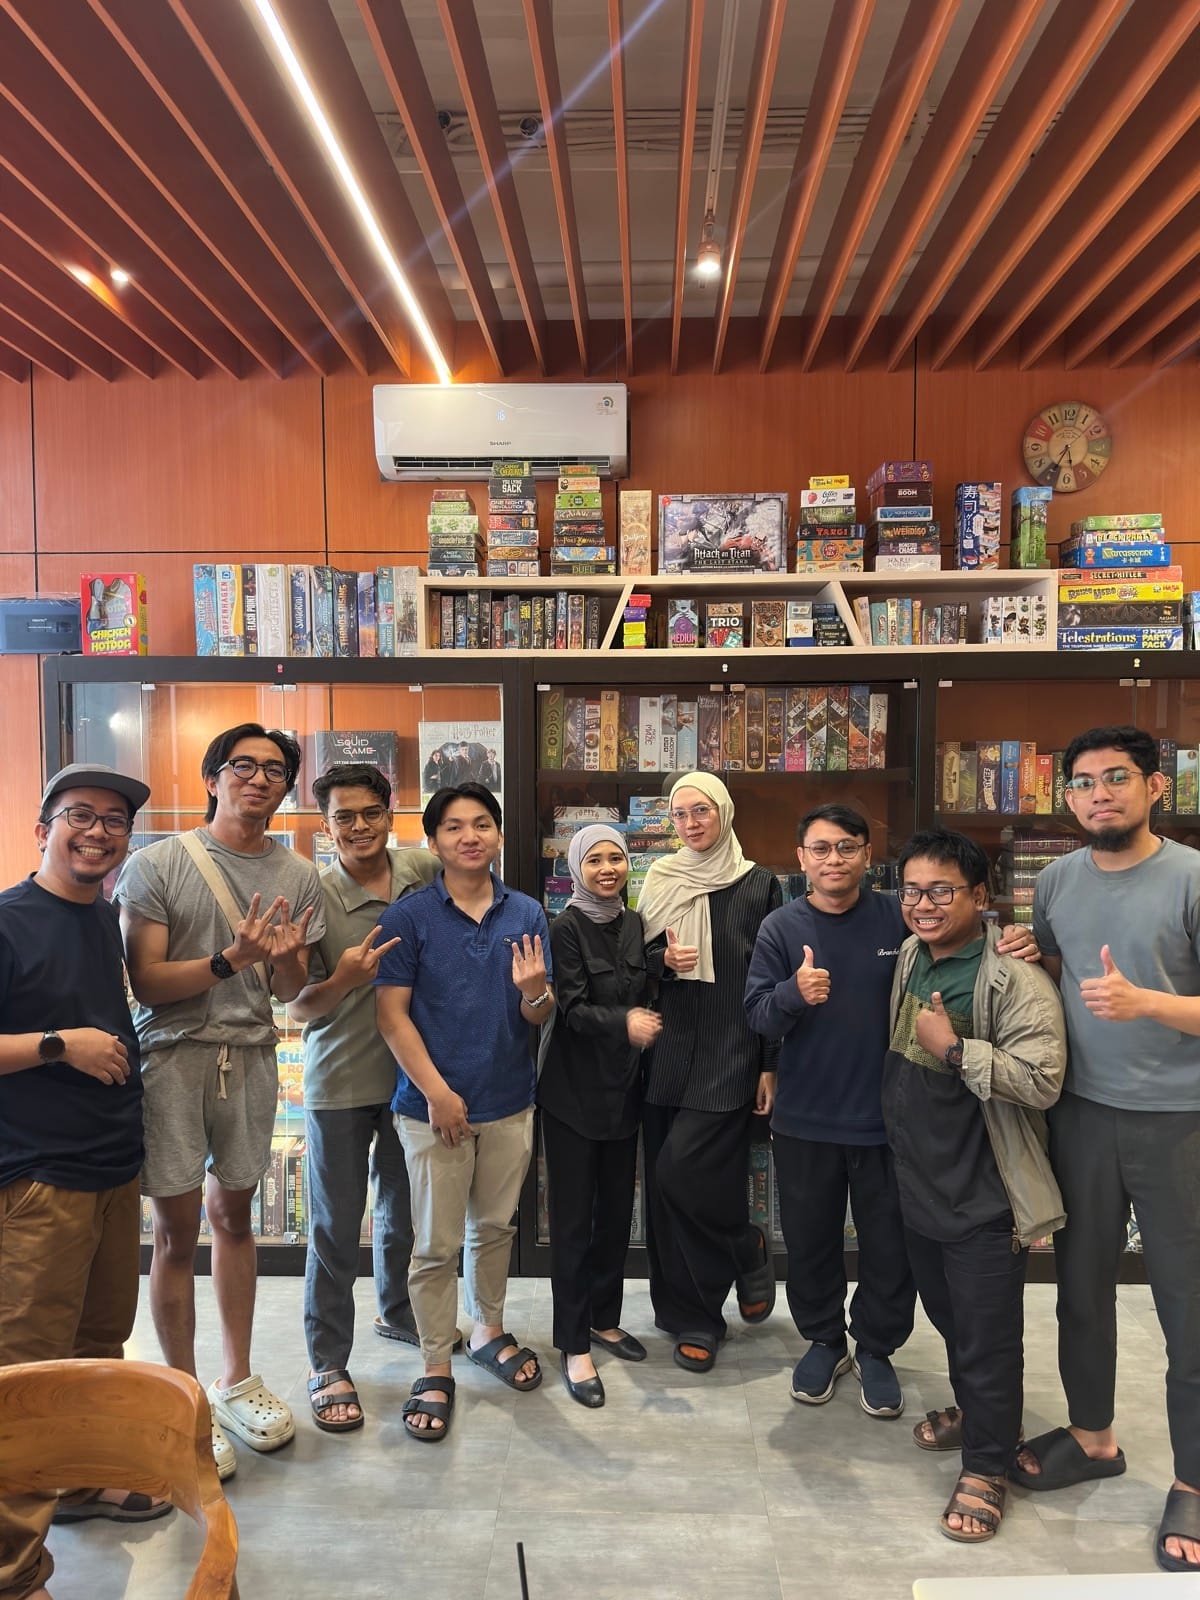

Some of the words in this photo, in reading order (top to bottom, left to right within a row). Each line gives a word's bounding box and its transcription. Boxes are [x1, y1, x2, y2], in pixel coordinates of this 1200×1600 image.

[502, 485, 522, 493] SACK
[816, 527, 848, 536] TARGI
[893, 528, 926, 536] WENDIGO
[694, 548, 720, 559] Attack
[729, 548, 751, 558] Titan
[572, 565, 594, 573] DUEL
[247, 595, 256, 612] POINT
[337, 584, 347, 612] RISING
[247, 613, 256, 631] FLASH
[711, 617, 739, 627] TRIO
[90, 628, 131, 639] CHICKEN
[337, 613, 347, 648] THANOS
[670, 633, 697, 643] MEDIUM
[1061, 630, 1137, 643] Telestrations
[91, 640, 131, 652] HOTDOG
[1142, 641, 1166, 649] PACK
[547, 709, 560, 746] CACAO
[334, 736, 369, 748] SQUID
[343, 747, 377, 757] GAME
